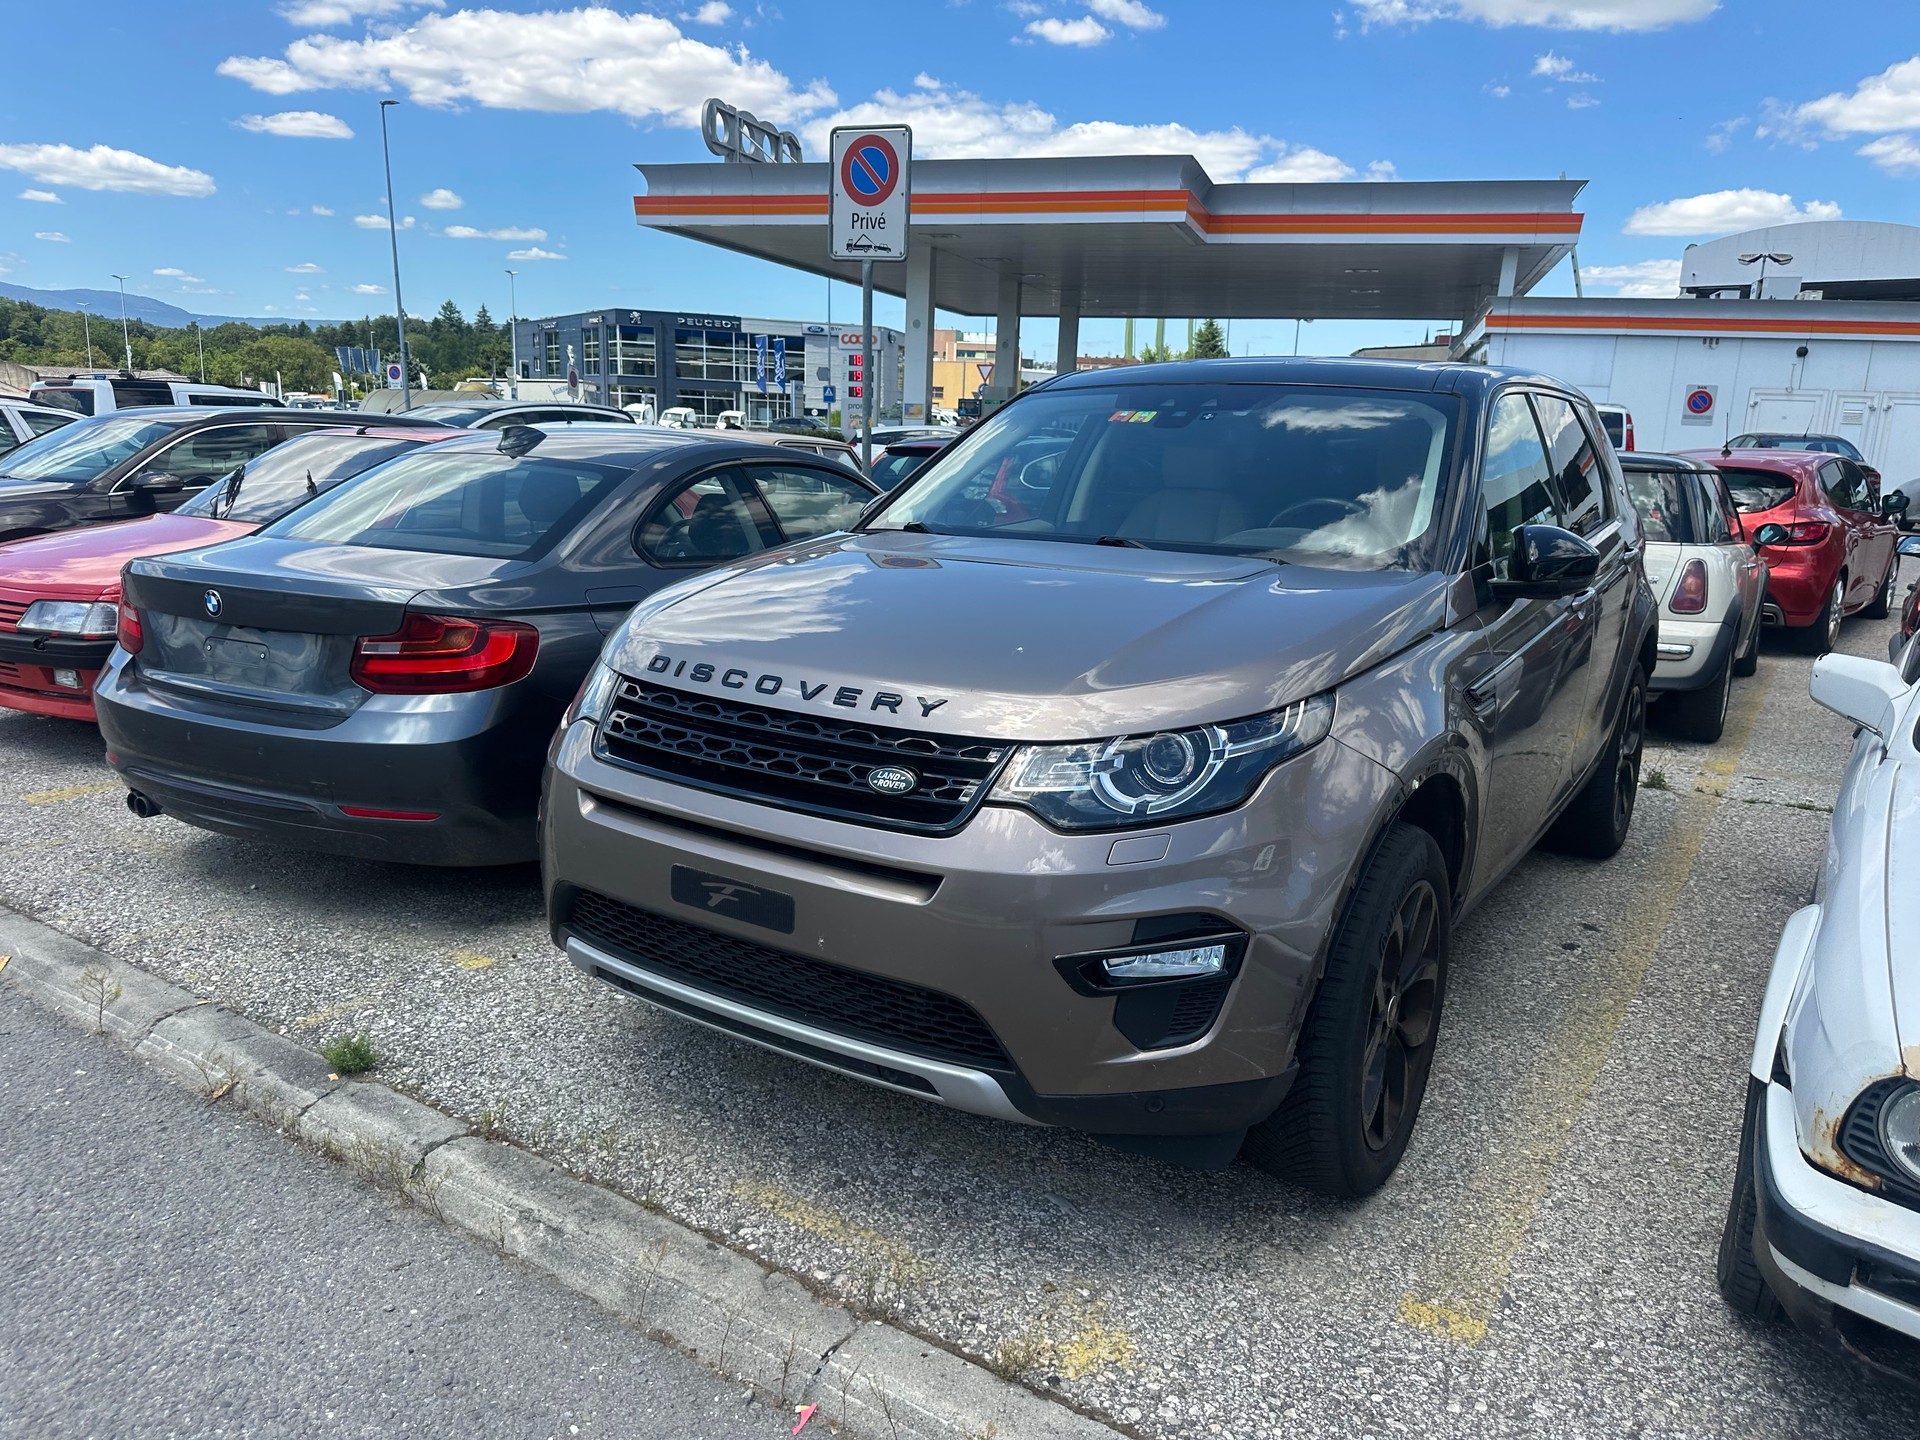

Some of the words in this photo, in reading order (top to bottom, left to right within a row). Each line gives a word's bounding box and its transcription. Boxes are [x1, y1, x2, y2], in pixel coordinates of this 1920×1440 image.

[851, 212, 886, 230] Privé
[677, 317, 740, 328] PEUGEOT
[647, 655, 949, 718] DISCOVERY
[877, 771, 901, 780] LAND
[877, 779, 906, 790] ROVER
